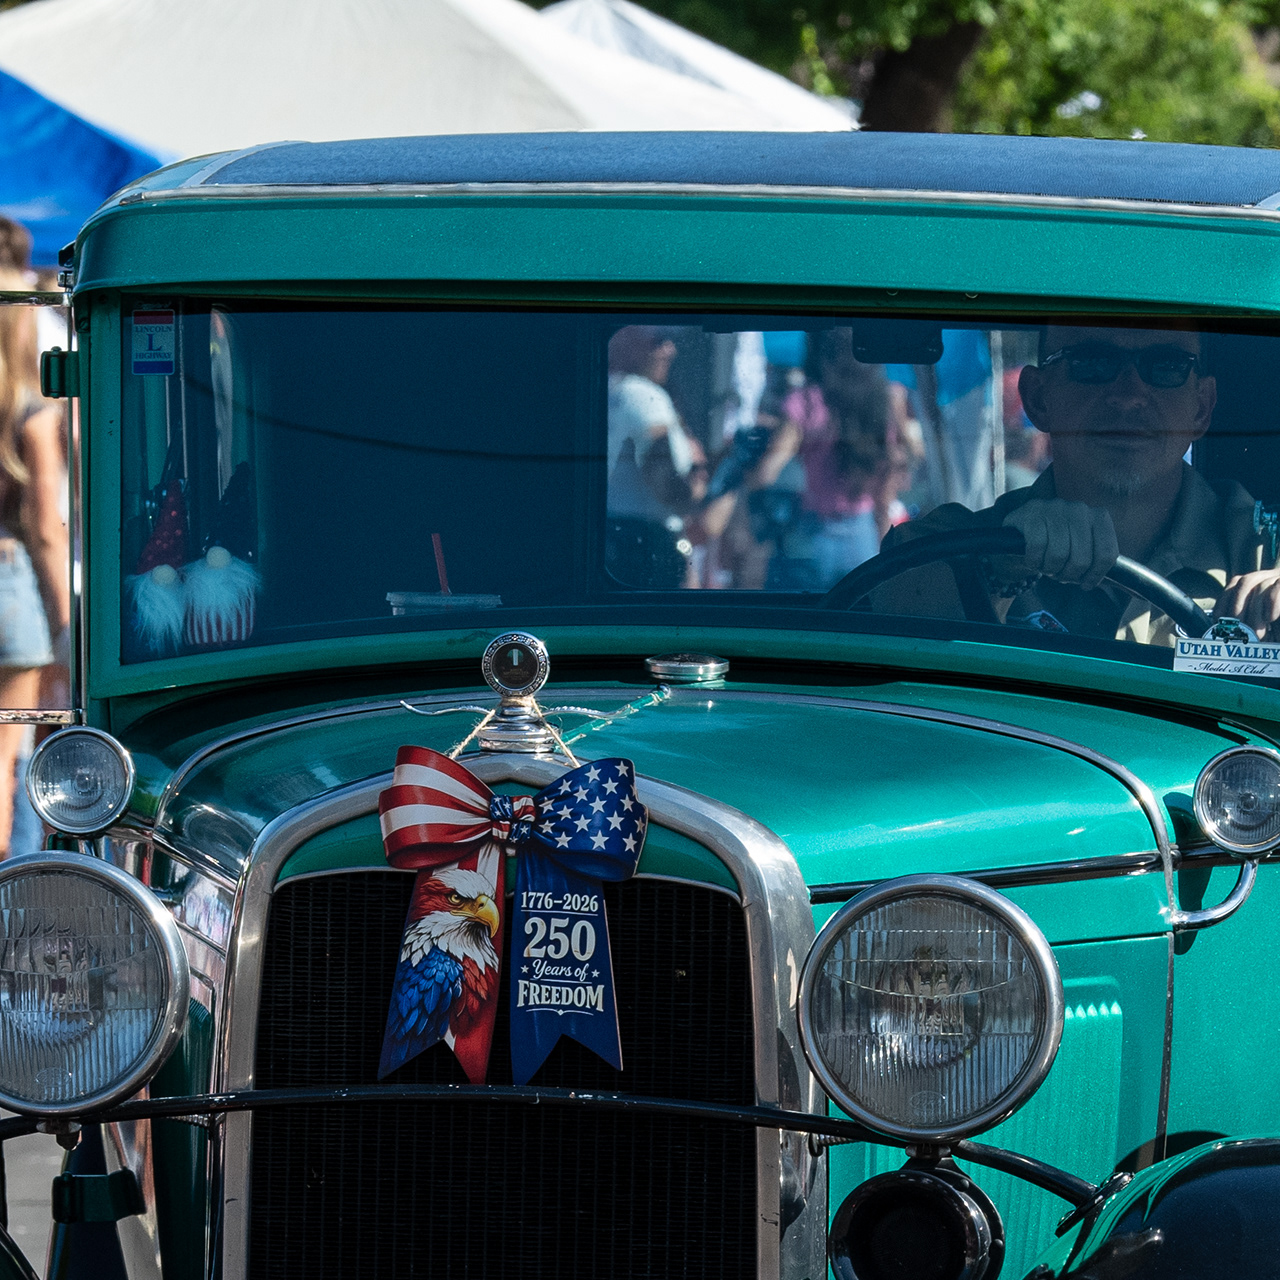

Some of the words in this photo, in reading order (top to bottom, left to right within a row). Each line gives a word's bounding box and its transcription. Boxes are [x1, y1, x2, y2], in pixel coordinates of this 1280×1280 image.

[1180, 642, 1221, 657] UTAH
[1224, 644, 1280, 660] VALLEY
[1194, 662, 1229, 673] Model
[1243, 664, 1269, 674] Club
[523, 916, 596, 961] 250
[532, 959, 572, 978] Years
[574, 962, 589, 982] of
[517, 980, 604, 1012] FREEDOM
